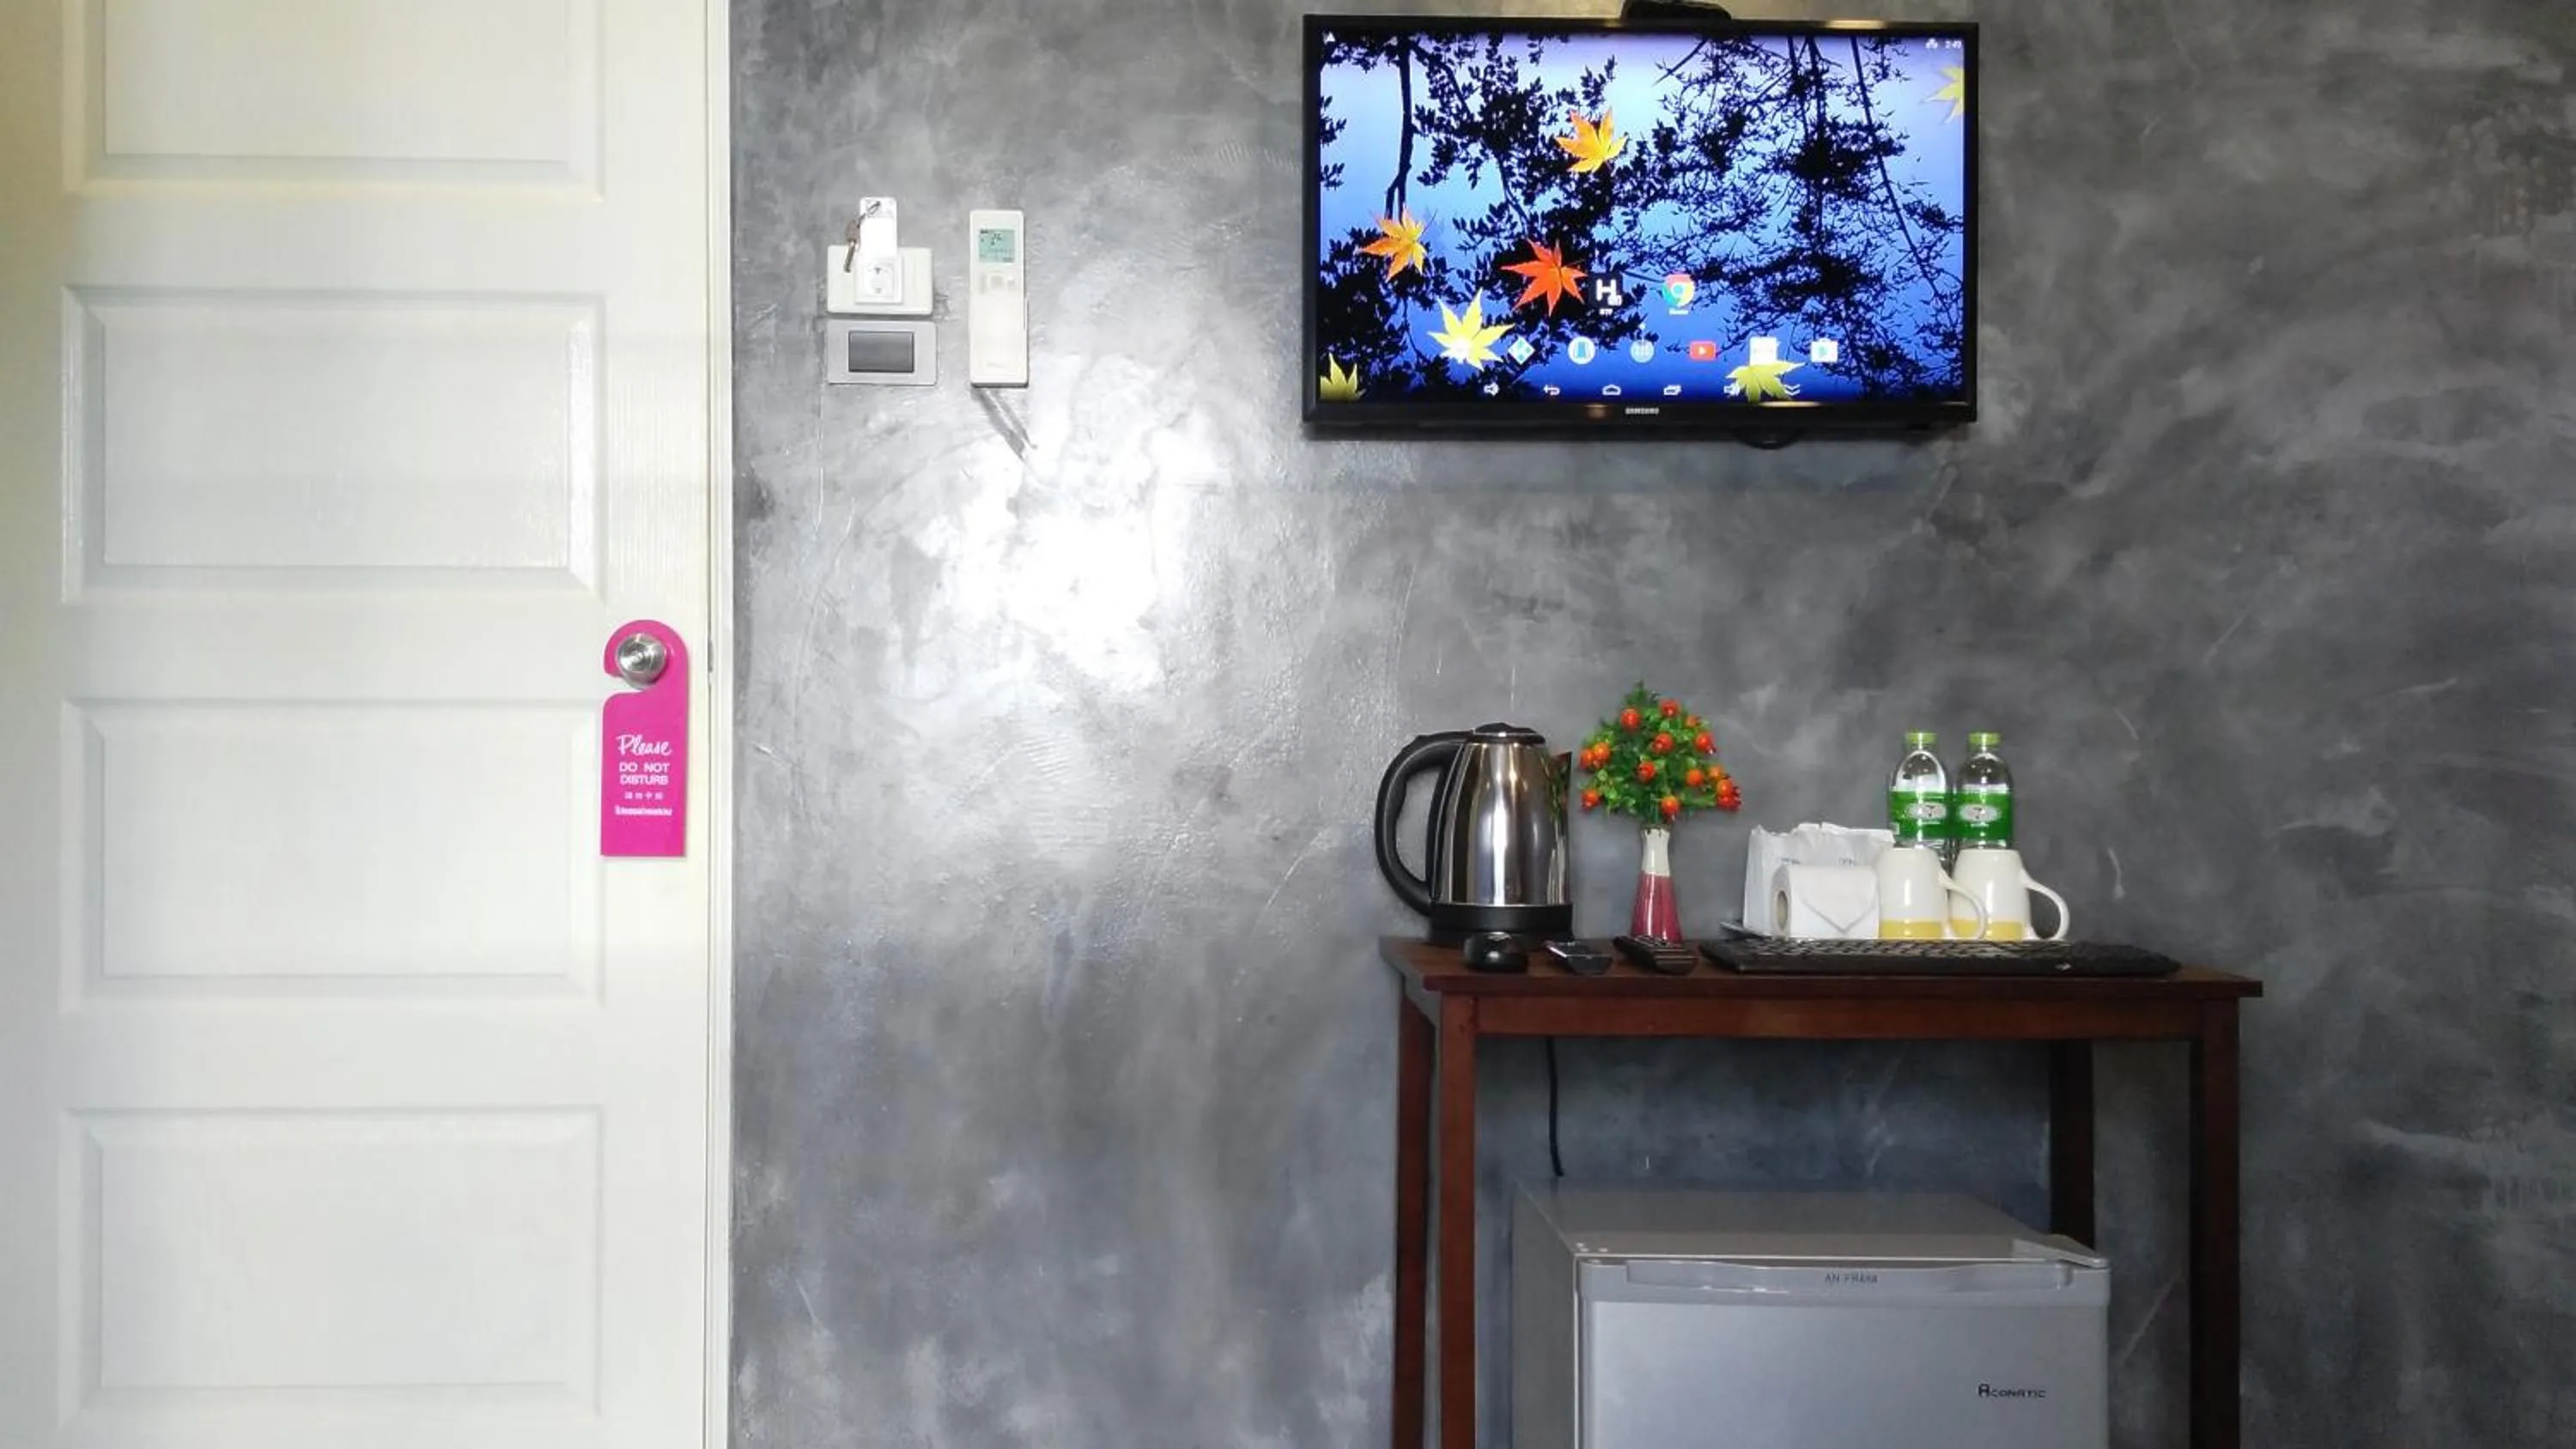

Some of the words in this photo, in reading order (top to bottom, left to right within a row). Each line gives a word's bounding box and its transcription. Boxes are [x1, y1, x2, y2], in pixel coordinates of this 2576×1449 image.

[616, 734, 672, 756] Please
[619, 761, 638, 773] DO
[643, 761, 671, 773] NOT
[619, 774, 669, 785] DISTURB
